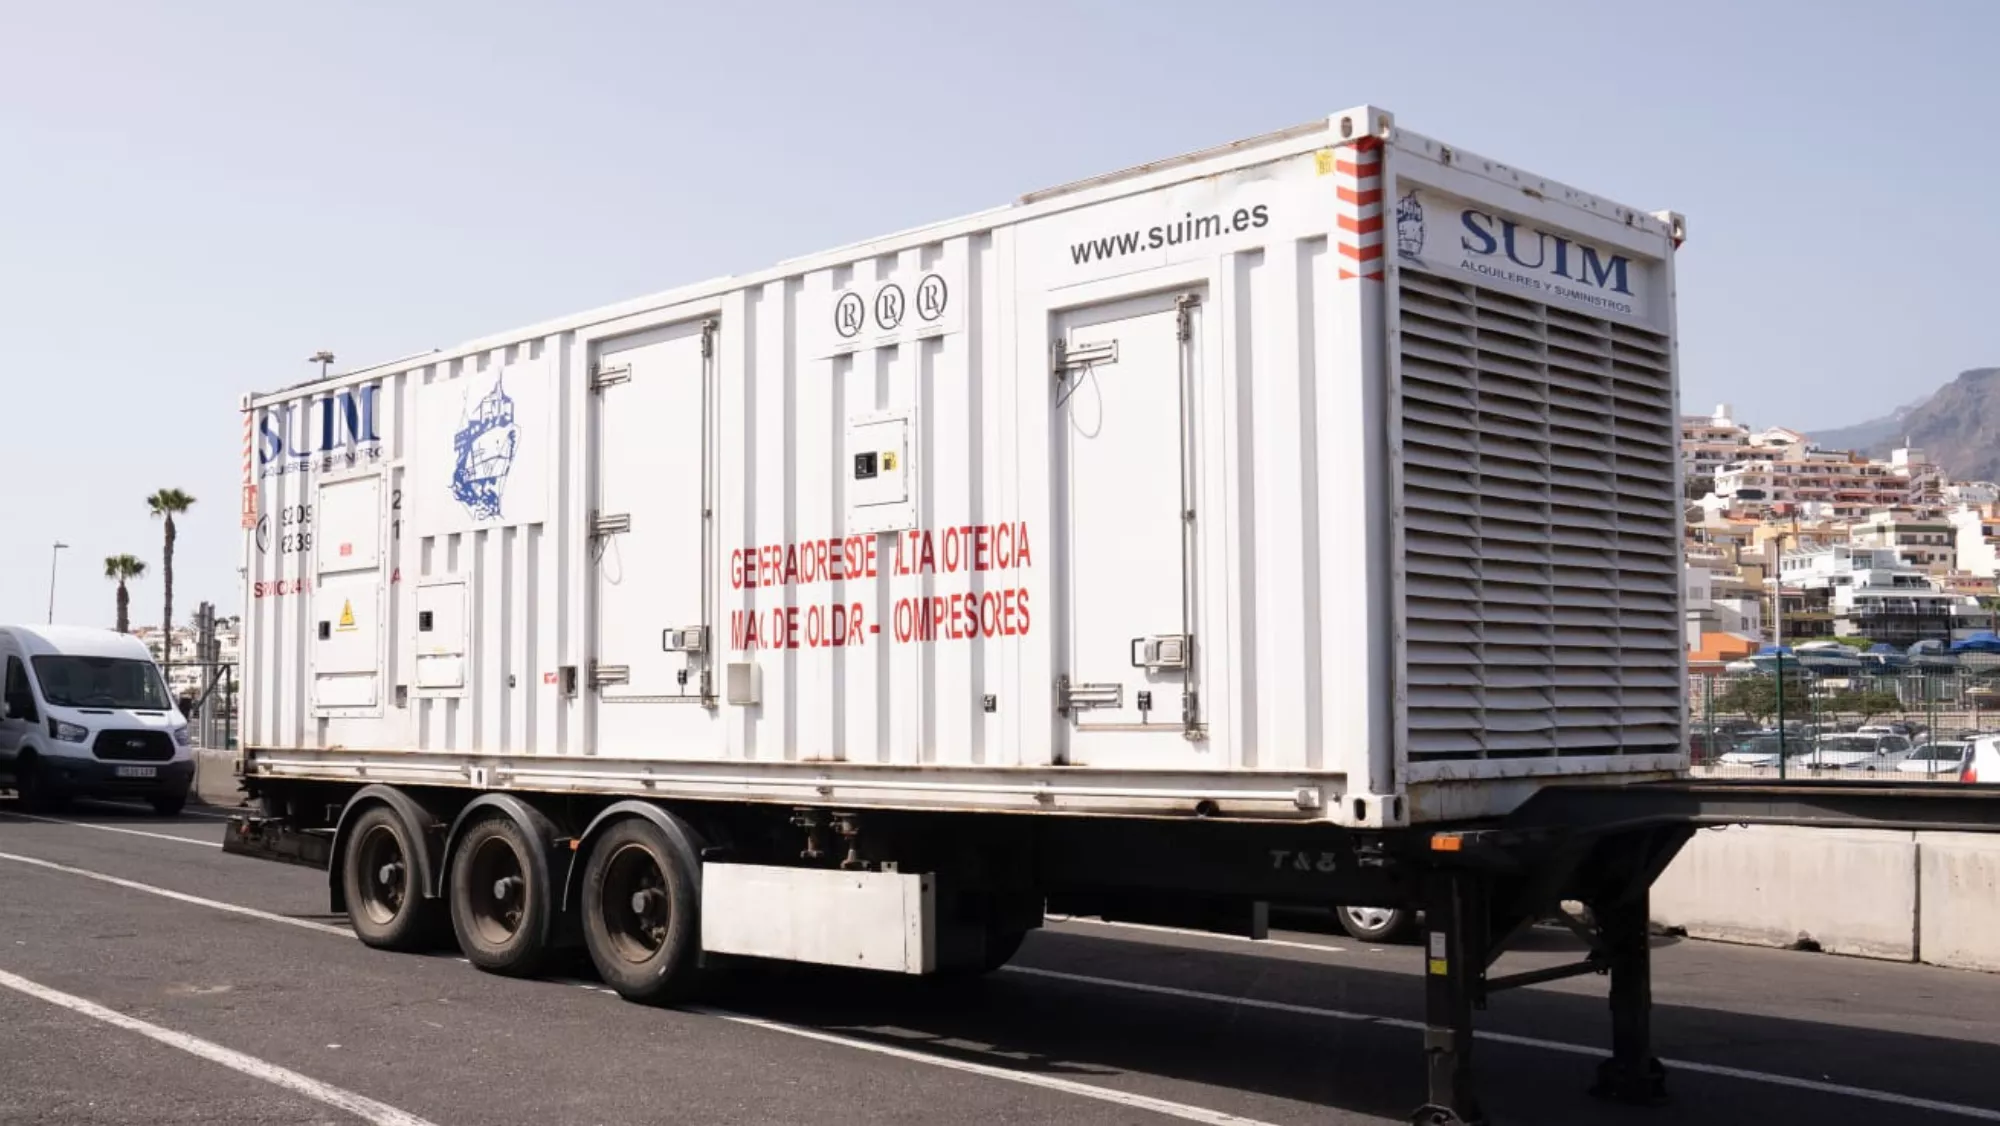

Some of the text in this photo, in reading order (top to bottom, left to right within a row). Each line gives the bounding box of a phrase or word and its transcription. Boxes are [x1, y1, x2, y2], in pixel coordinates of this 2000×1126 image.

[1071, 204, 1269, 264] www.suim.es
[1460, 209, 1635, 297] SUIM
[1460, 259, 1632, 314] ALQUILERES Y SUMINISTROS
[773, 606, 800, 649] DE
